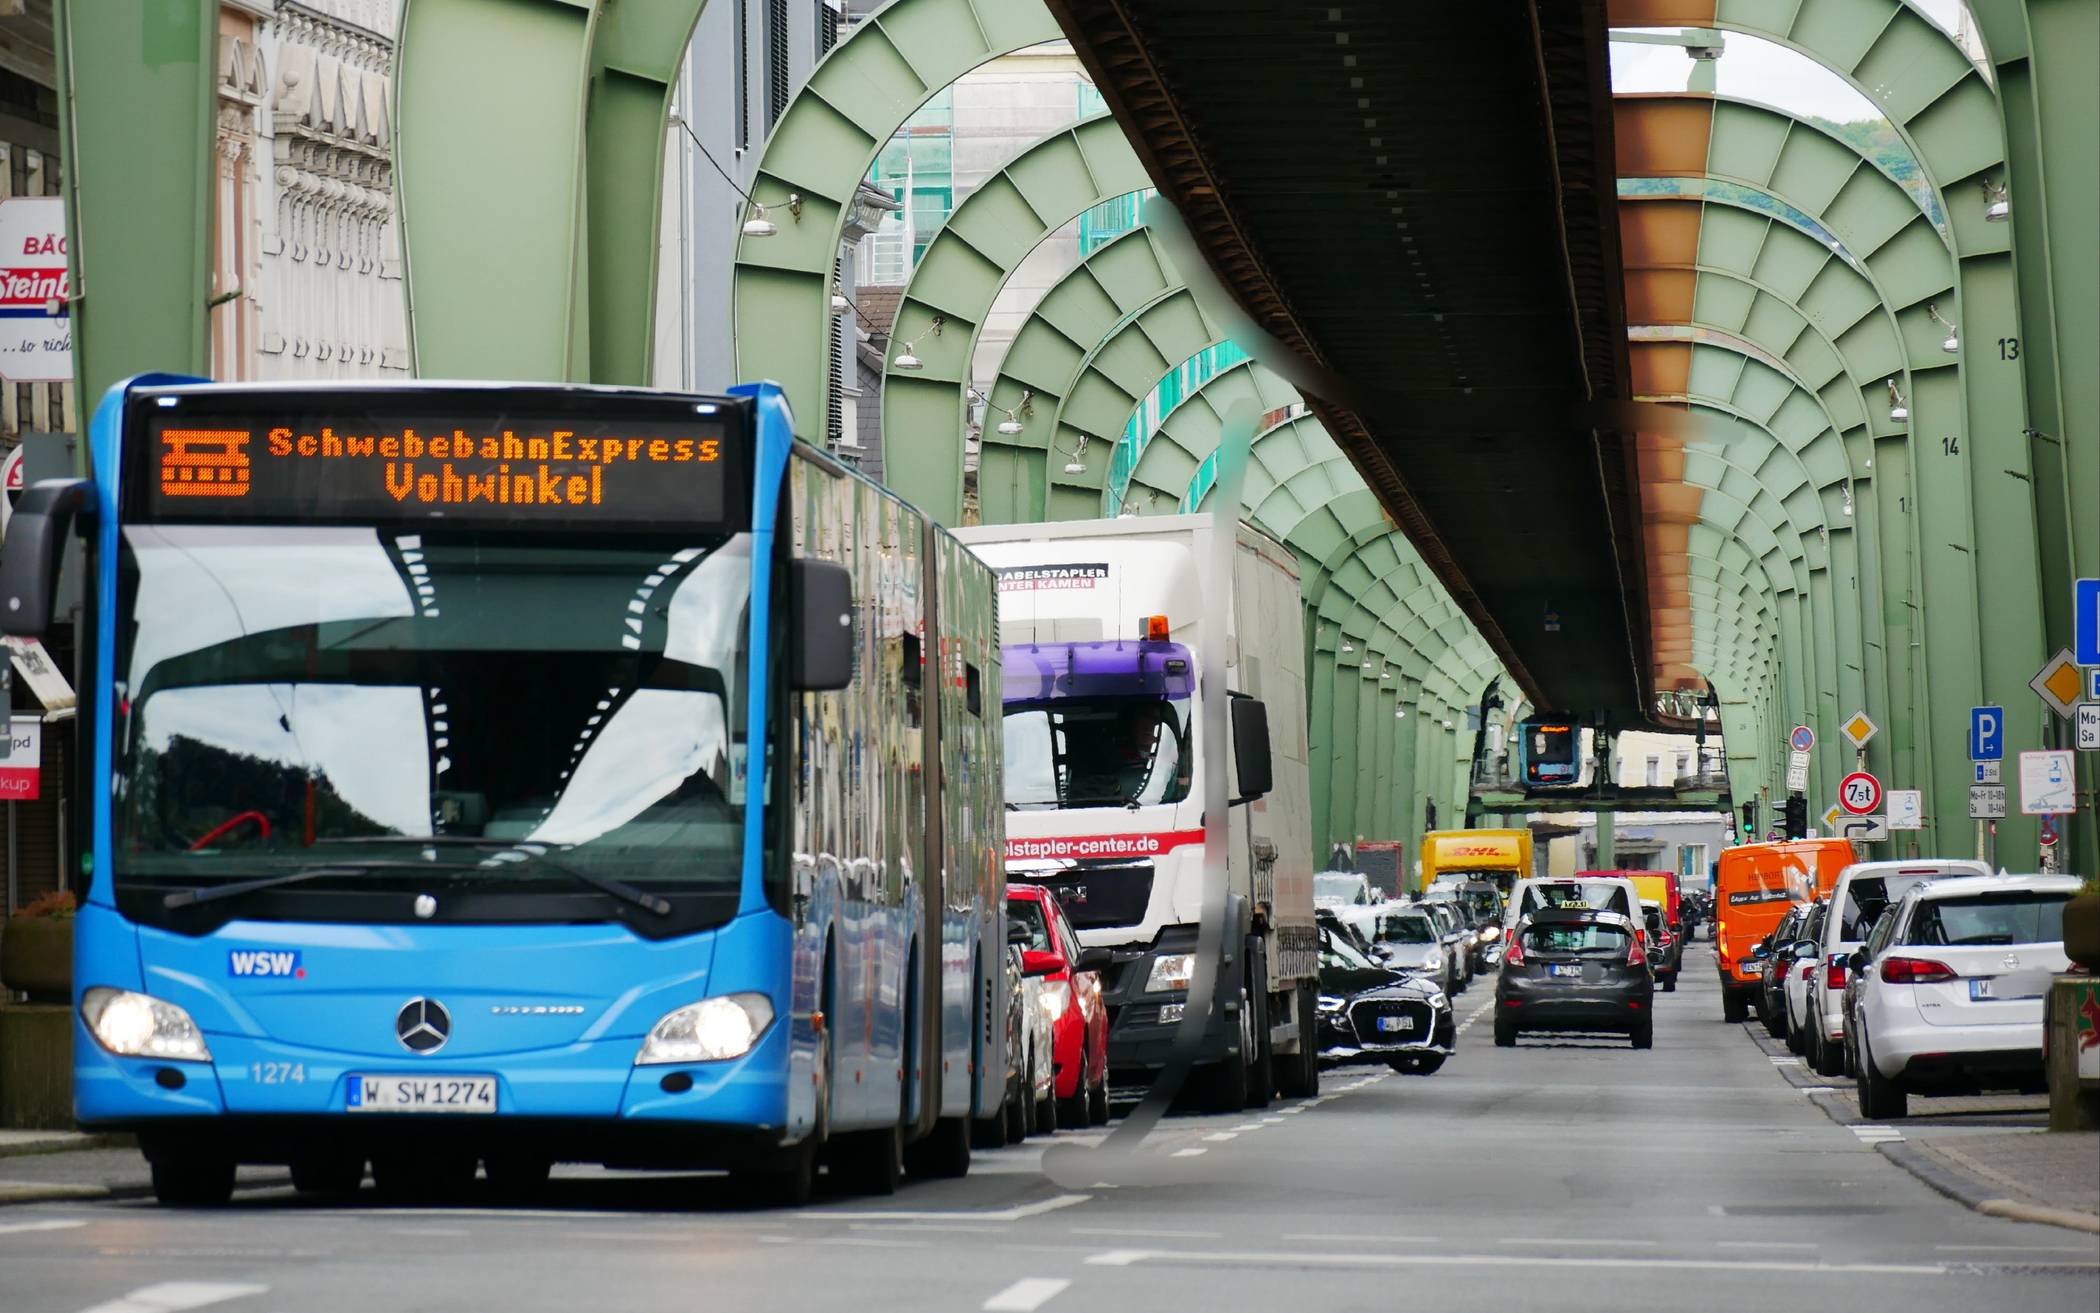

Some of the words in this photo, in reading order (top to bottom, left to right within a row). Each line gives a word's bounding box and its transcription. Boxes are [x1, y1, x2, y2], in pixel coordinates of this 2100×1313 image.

[1998, 338, 2019, 360] 13
[268, 427, 719, 463] SchwebebahnExpress
[1942, 437, 1959, 456] 14
[385, 463, 601, 504] Vohwinkel
[1038, 578, 1093, 589] KAMEN
[1979, 714, 1996, 753] P
[2081, 730, 2094, 742] Sa
[231, 952, 295, 977] WSW
[1979, 982, 1989, 996] W
[251, 1062, 305, 1084] 1274
[365, 1081, 380, 1103] W
